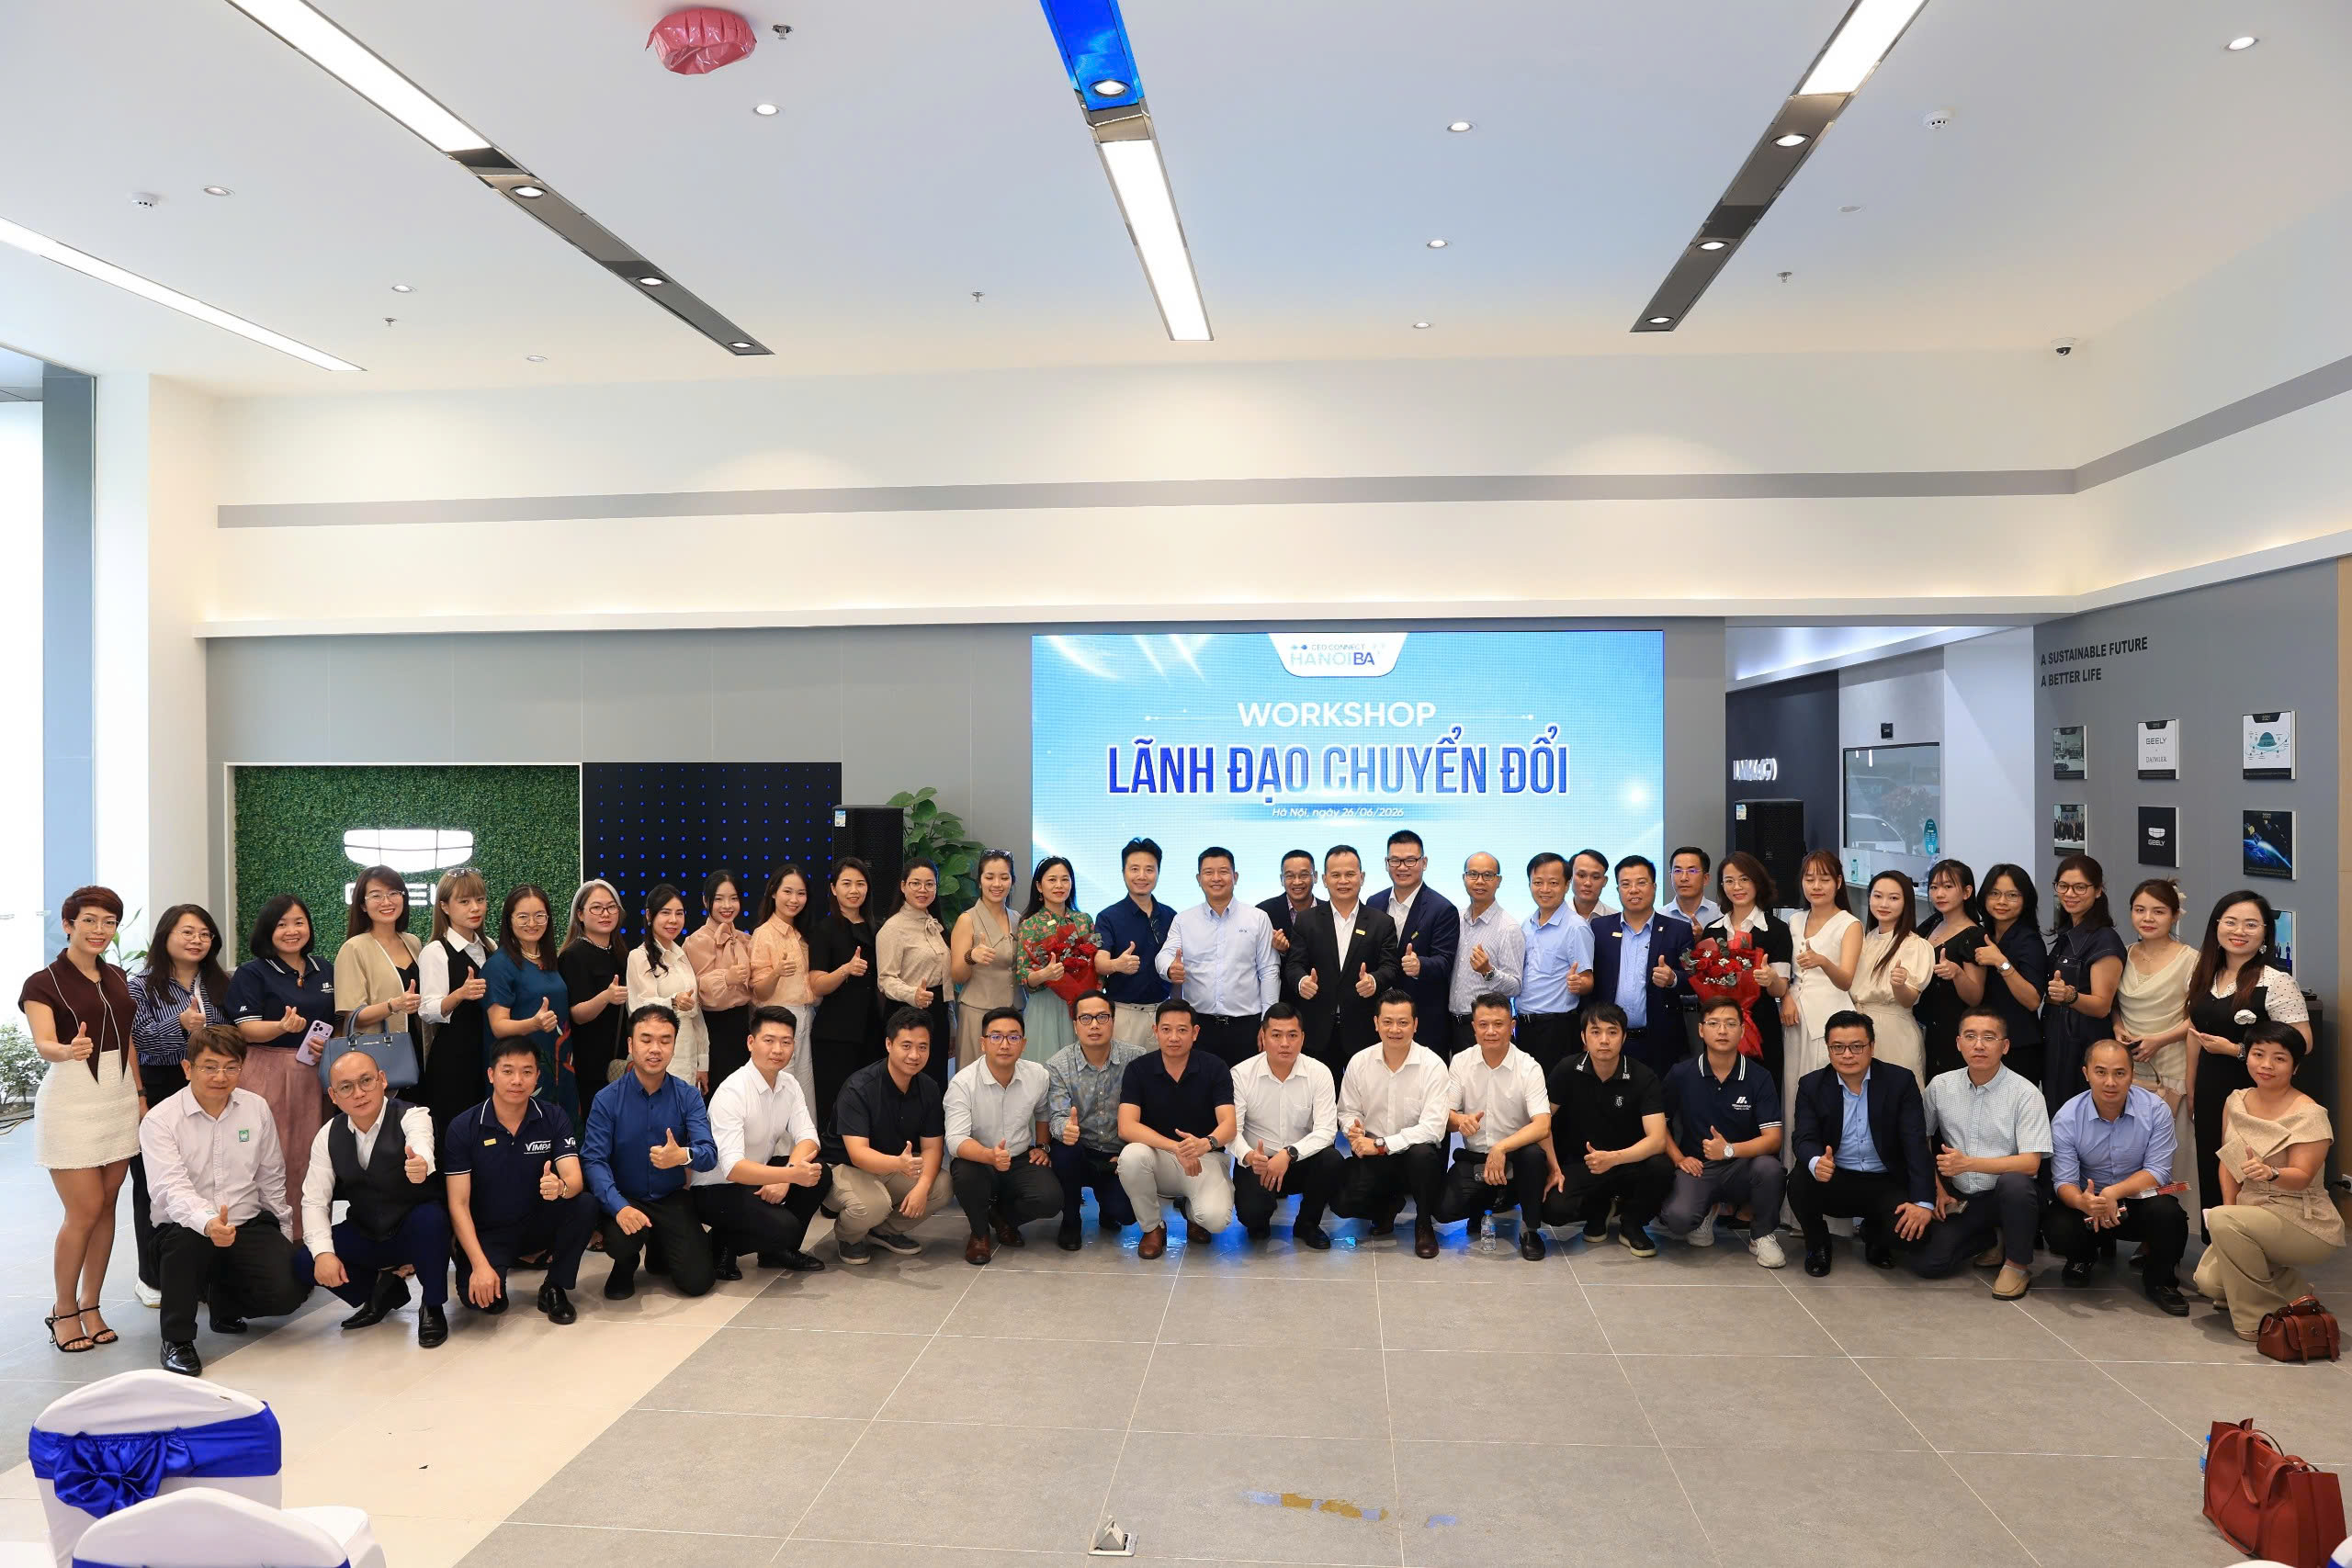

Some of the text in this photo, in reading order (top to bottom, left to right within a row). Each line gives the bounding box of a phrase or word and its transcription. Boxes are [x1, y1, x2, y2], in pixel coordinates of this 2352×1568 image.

[2041, 637, 2148, 666] A SUSTAINABLE FUTURE
[2041, 668, 2102, 687] A BETTER LIFE
[1238, 701, 1437, 728] WORKSHOP
[2145, 737, 2167, 745] GEELY
[1108, 726, 1567, 804] LÃNH ĐẠO CHUYỂN ĐỔI
[1312, 807, 1340, 818] ngày
[1341, 807, 1405, 818] 26/06/2026
